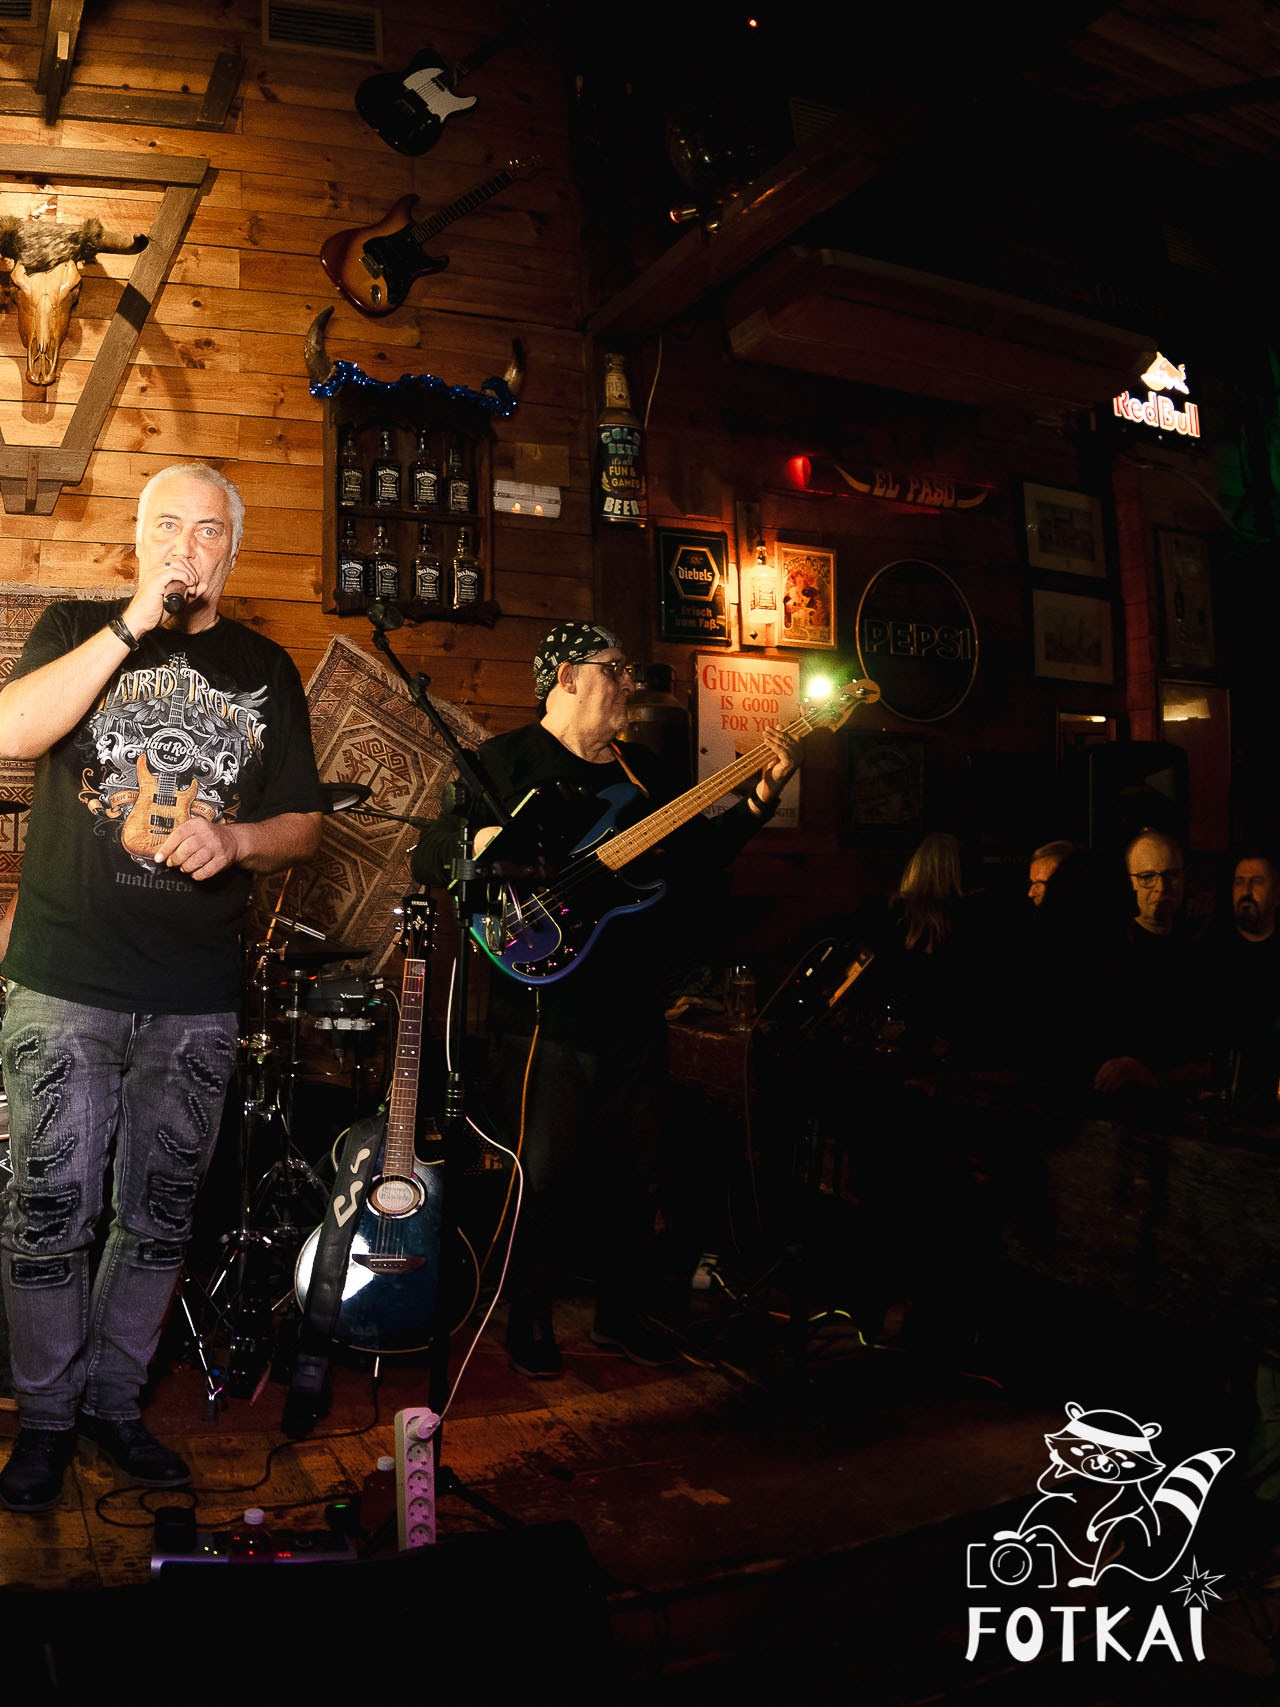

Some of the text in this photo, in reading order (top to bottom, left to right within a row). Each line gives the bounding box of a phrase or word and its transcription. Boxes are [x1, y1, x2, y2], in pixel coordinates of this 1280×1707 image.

[872, 467, 957, 509] EL PASO
[603, 496, 641, 516] BEER
[677, 565, 714, 582] Diebels
[864, 617, 972, 663] PEPSI
[720, 695, 780, 715] IS GOOD
[721, 714, 749, 732] FOR
[143, 736, 202, 761] Hard Rock
[162, 753, 180, 765] CAFE
